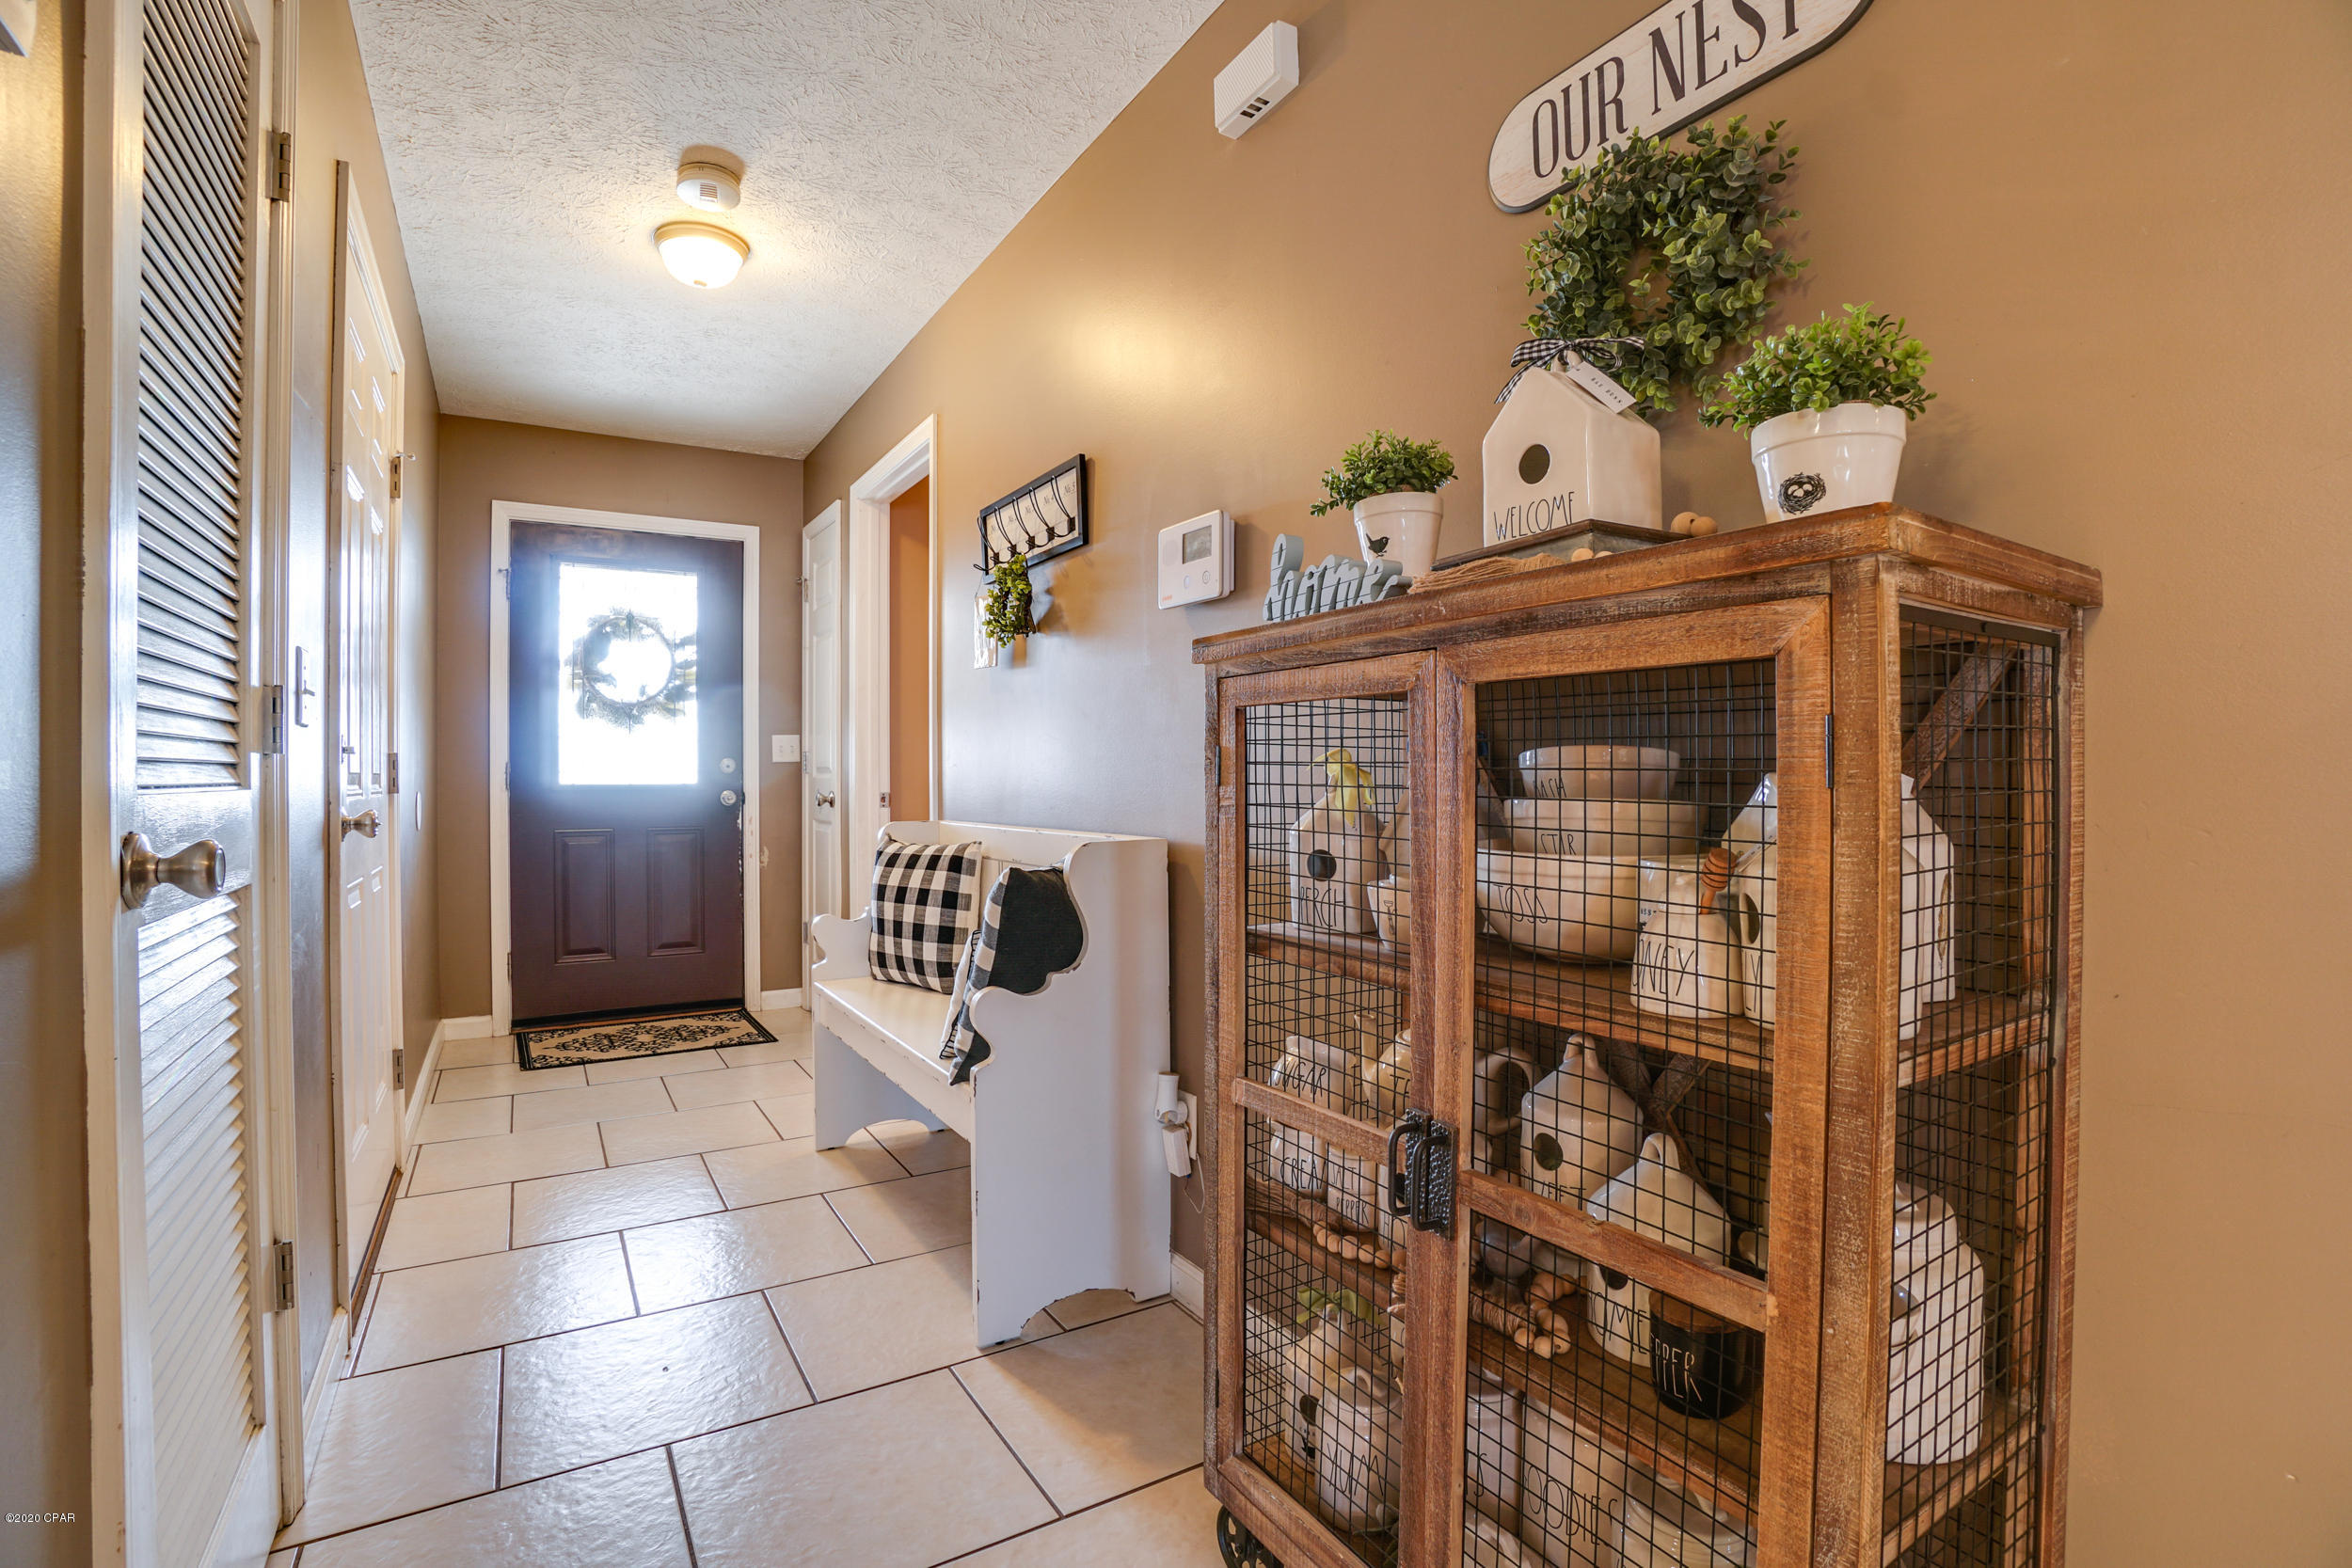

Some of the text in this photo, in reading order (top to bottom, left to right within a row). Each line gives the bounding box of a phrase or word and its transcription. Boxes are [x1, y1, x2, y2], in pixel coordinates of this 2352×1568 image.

[1532, 55, 1629, 179] OUR
[1493, 491, 1575, 541] WELCOME
[1262, 533, 1412, 623] home
[1299, 886, 1346, 927] PERCH
[1492, 883, 1549, 925] TOSS
[1330, 1164, 1357, 1190] SALT
[1336, 1196, 1370, 1225] PPPER
[1650, 1332, 1703, 1402] PPER
[1327, 1442, 1384, 1497] YUM
[1523, 1465, 1618, 1547] OODIES
